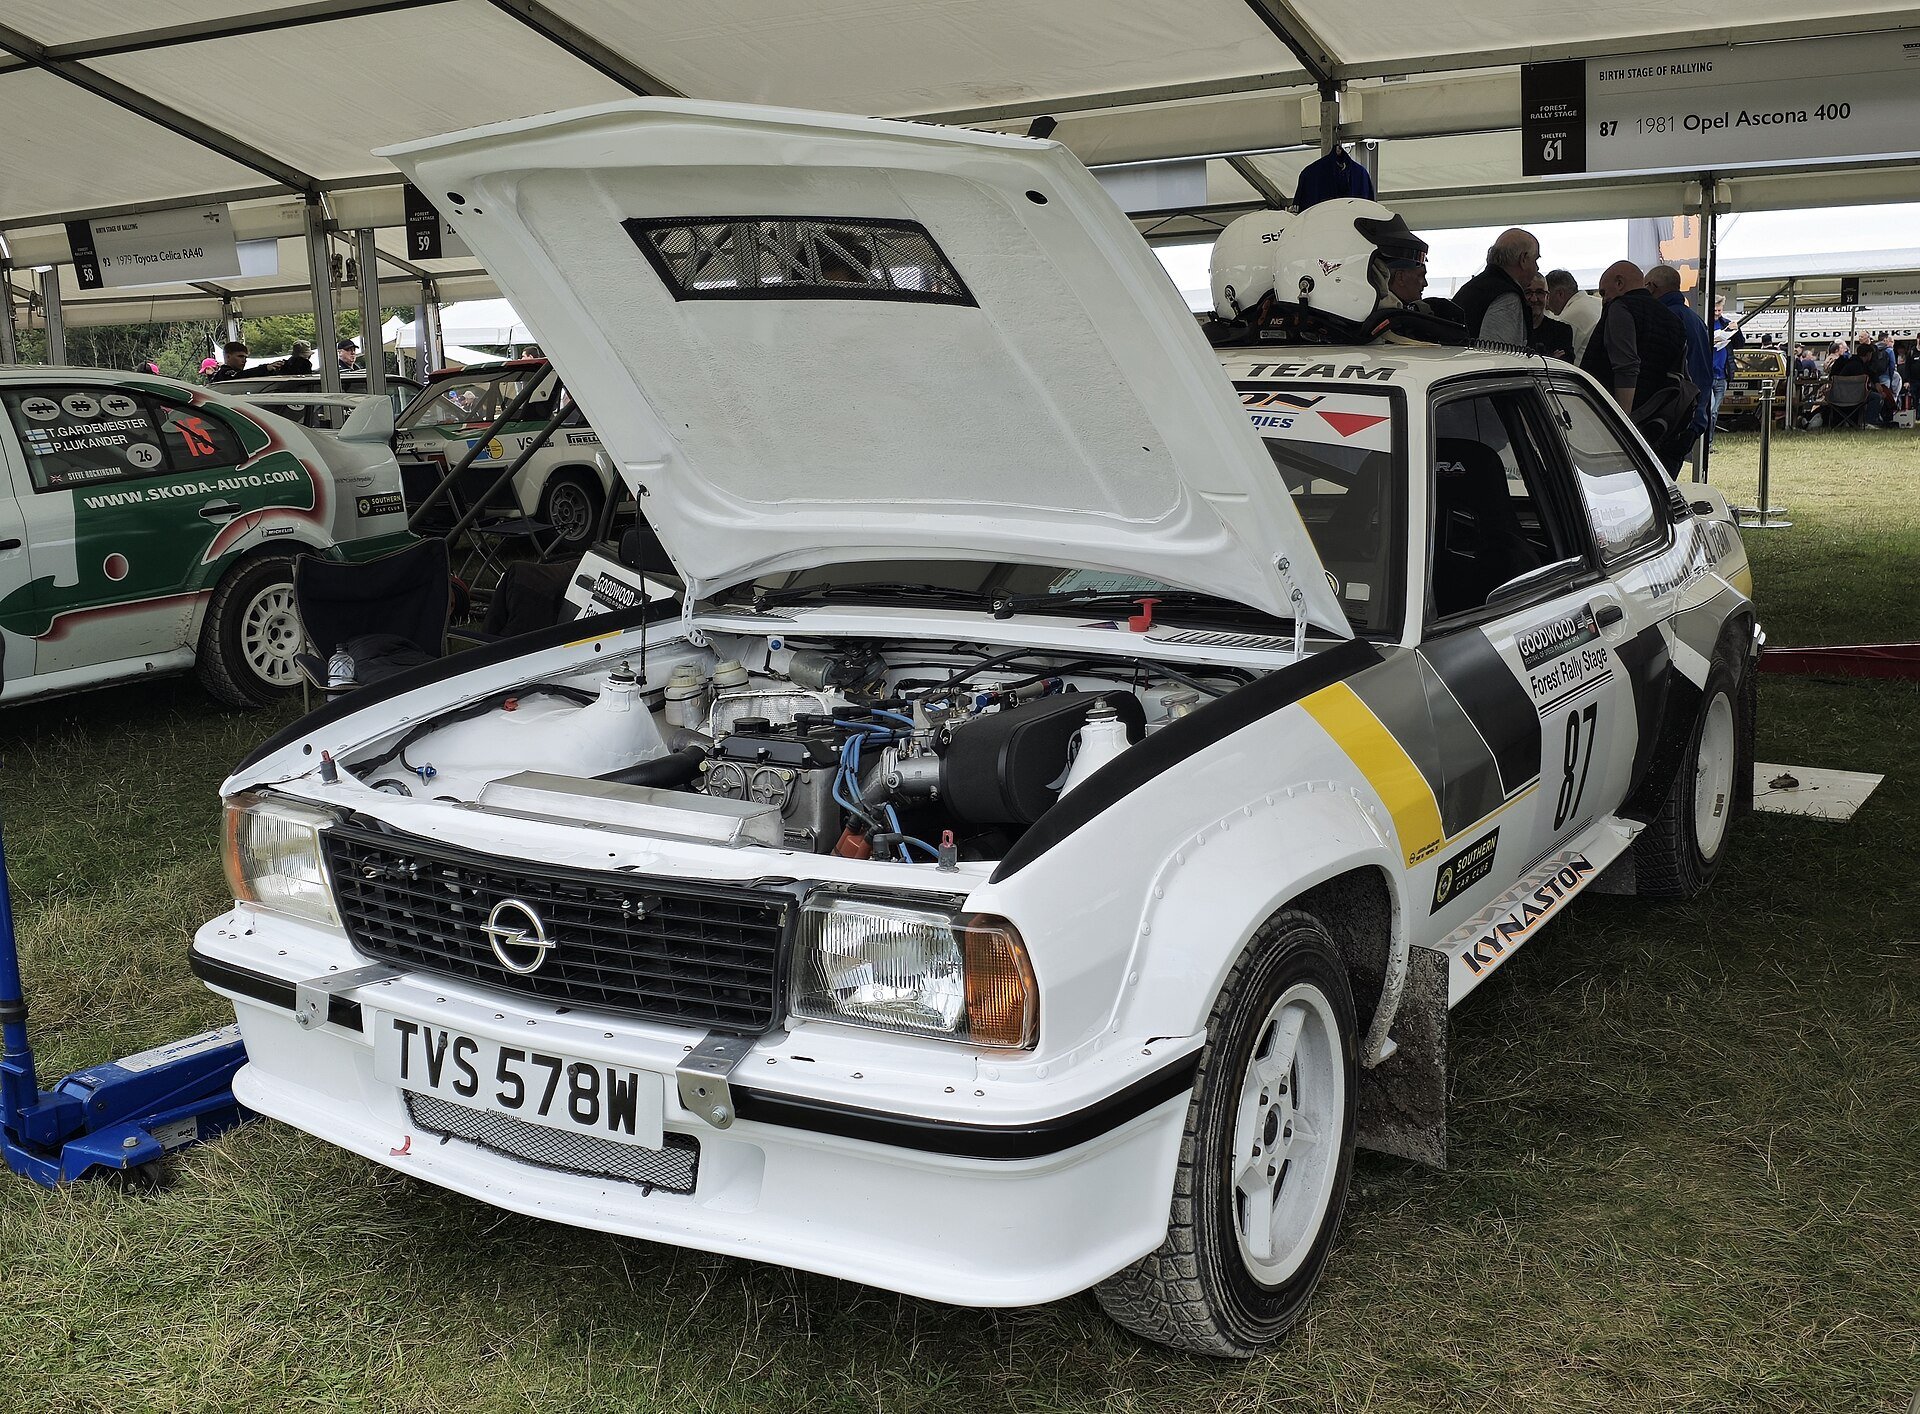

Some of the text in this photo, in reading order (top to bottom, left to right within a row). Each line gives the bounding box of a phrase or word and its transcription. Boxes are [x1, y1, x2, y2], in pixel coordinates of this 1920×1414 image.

[1599, 61, 1713, 81] BIRTH STAGE OF RALLYING
[1539, 104, 1567, 112] FOREST
[1554, 110, 1578, 118] STAGE
[1599, 102, 1851, 137] 87 1981 Opel Ascona 400
[1543, 139, 1563, 161] 61
[418, 236, 430, 251] 59
[1261, 228, 1286, 244] Sti
[103, 247, 204, 267] 93 1979 Toyota Celica RA40
[83, 268, 94, 281] 58
[1247, 363, 1397, 381] TEAM
[46, 418, 148, 439] T.GARDEMEISTER
[1250, 415, 1294, 429] DIES
[53, 434, 129, 452] P.LUKANDER
[566, 432, 600, 444] PIRELL
[136, 449, 153, 463] 26
[67, 467, 122, 482] STEVE ROCKINGHAM
[83, 470, 300, 510] WWW.SKODA-AUTO.COM
[371, 495, 402, 505] SOUTHERN
[597, 576, 635, 607] GOODWOOD
[1519, 617, 1576, 657] GOODWOOD
[1530, 647, 1608, 699] Forest Rally Stage
[1554, 701, 1598, 831] 87
[1456, 835, 1497, 873] SOUTHERN
[1455, 862, 1489, 891] CAR CLUB
[1460, 853, 1597, 977] KYNASTON
[393, 1018, 639, 1136] TVS 578W
